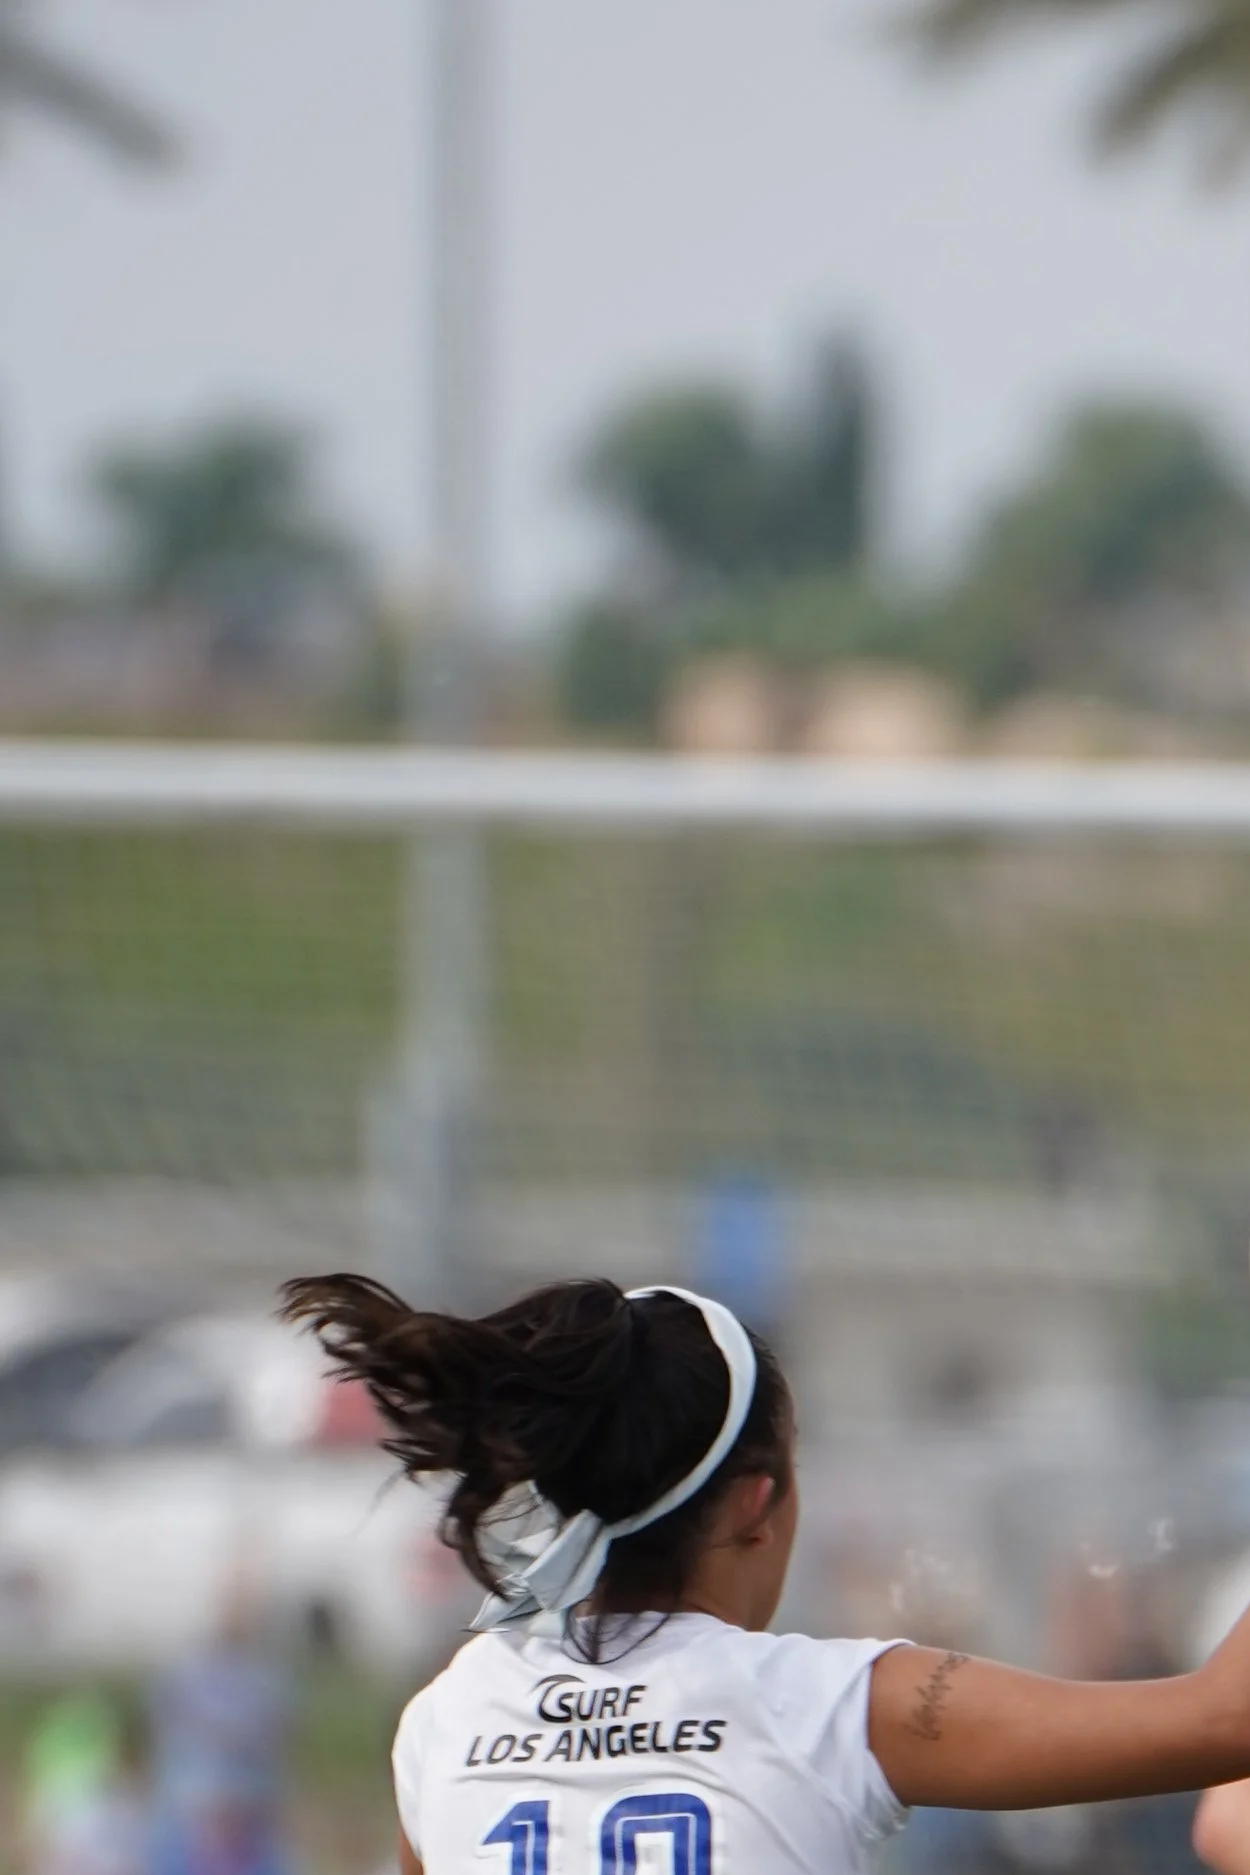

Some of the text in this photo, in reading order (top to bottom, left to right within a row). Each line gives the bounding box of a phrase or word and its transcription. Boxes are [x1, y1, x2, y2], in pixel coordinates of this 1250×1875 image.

[539, 1684, 648, 1723] SURF
[463, 1718, 728, 1767] LOS ANGELES
